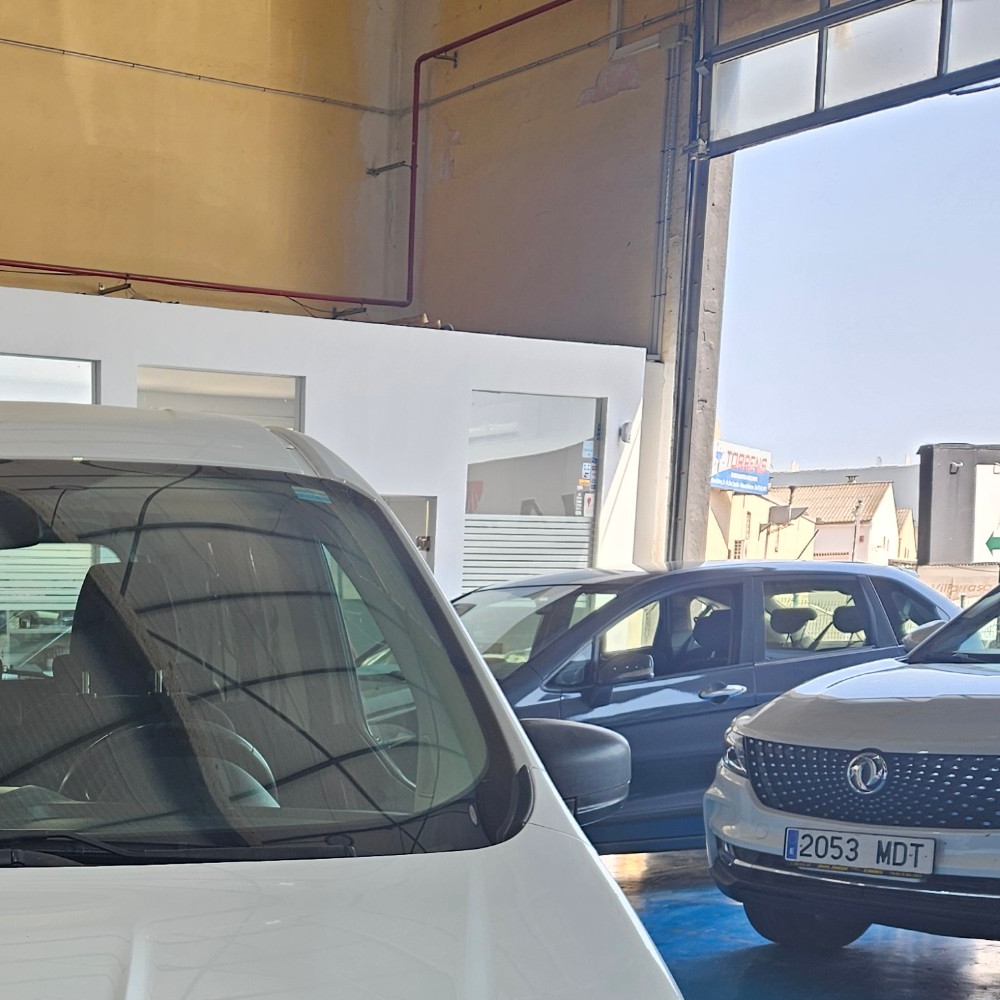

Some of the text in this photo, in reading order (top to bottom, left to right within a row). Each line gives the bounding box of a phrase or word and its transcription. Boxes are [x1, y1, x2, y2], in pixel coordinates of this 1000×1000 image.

[727, 450, 768, 474] TORRENS
[800, 833, 924, 868] 2053 MDT
